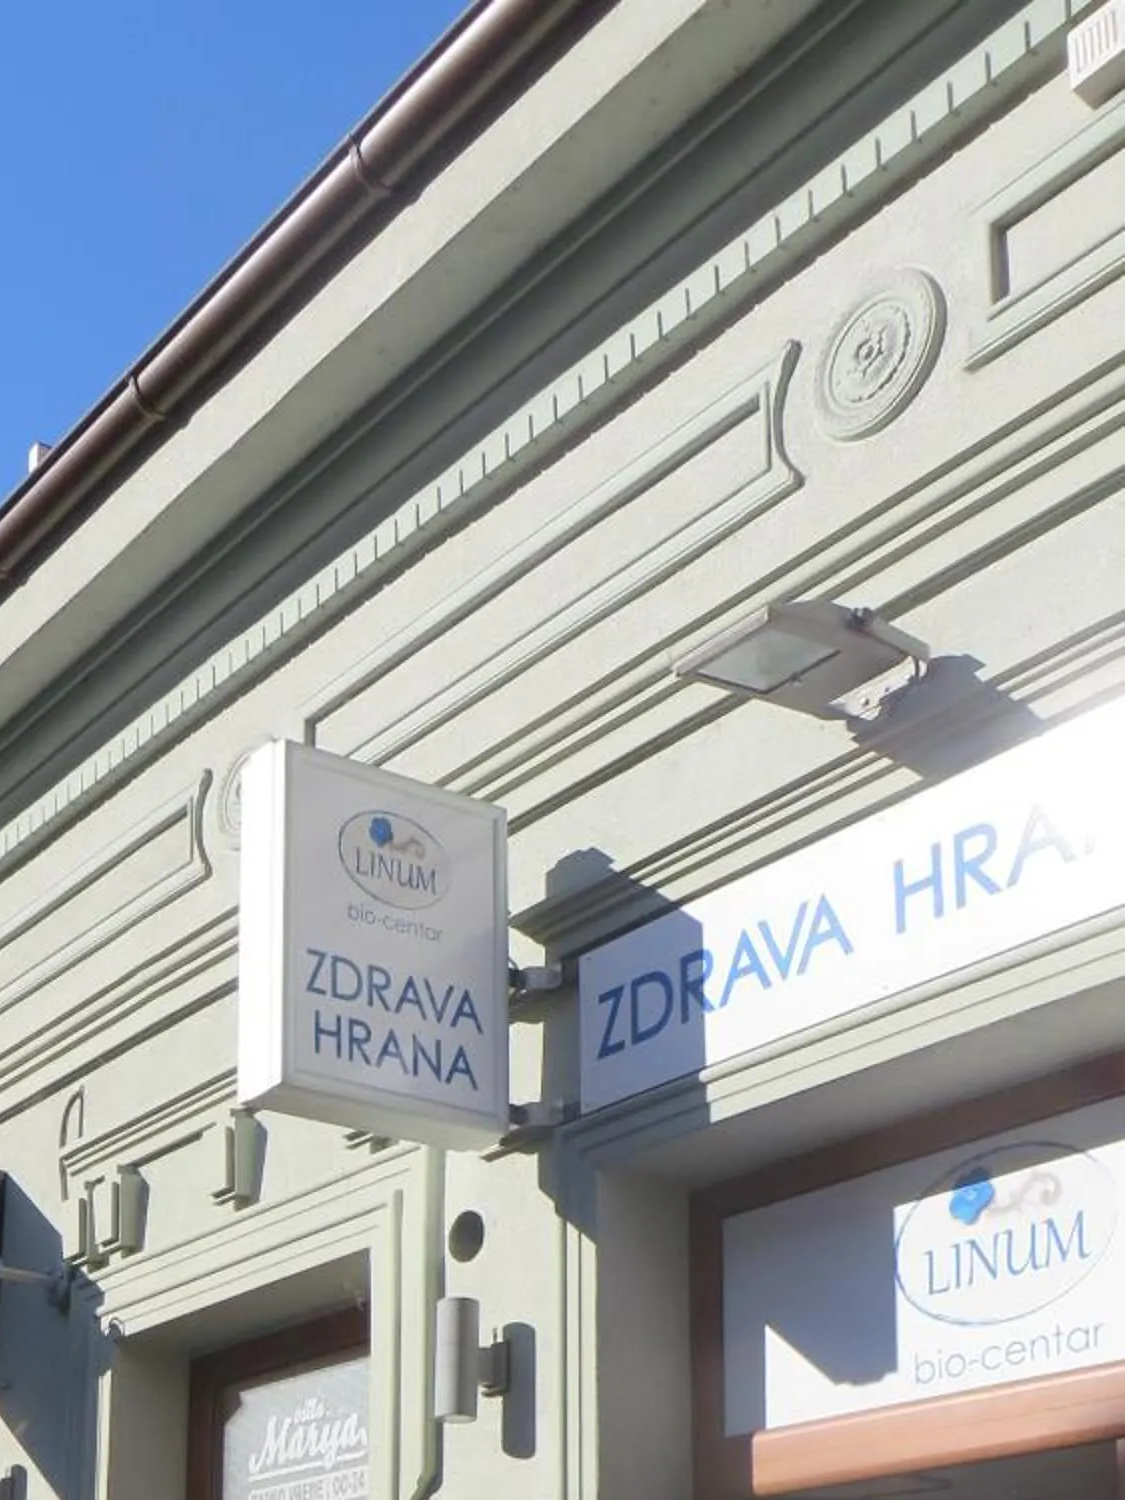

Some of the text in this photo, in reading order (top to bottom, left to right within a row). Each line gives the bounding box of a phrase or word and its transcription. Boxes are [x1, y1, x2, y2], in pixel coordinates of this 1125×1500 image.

[355, 847, 437, 895] LINUM
[347, 902, 444, 943] bio-centar
[596, 803, 1099, 1061] ZDRAVA HRA
[306, 948, 484, 1034] ZDRAVA
[314, 1010, 478, 1091] HRANA
[923, 1210, 1091, 1295] LINUM
[915, 1323, 1104, 1384] bio-centar
